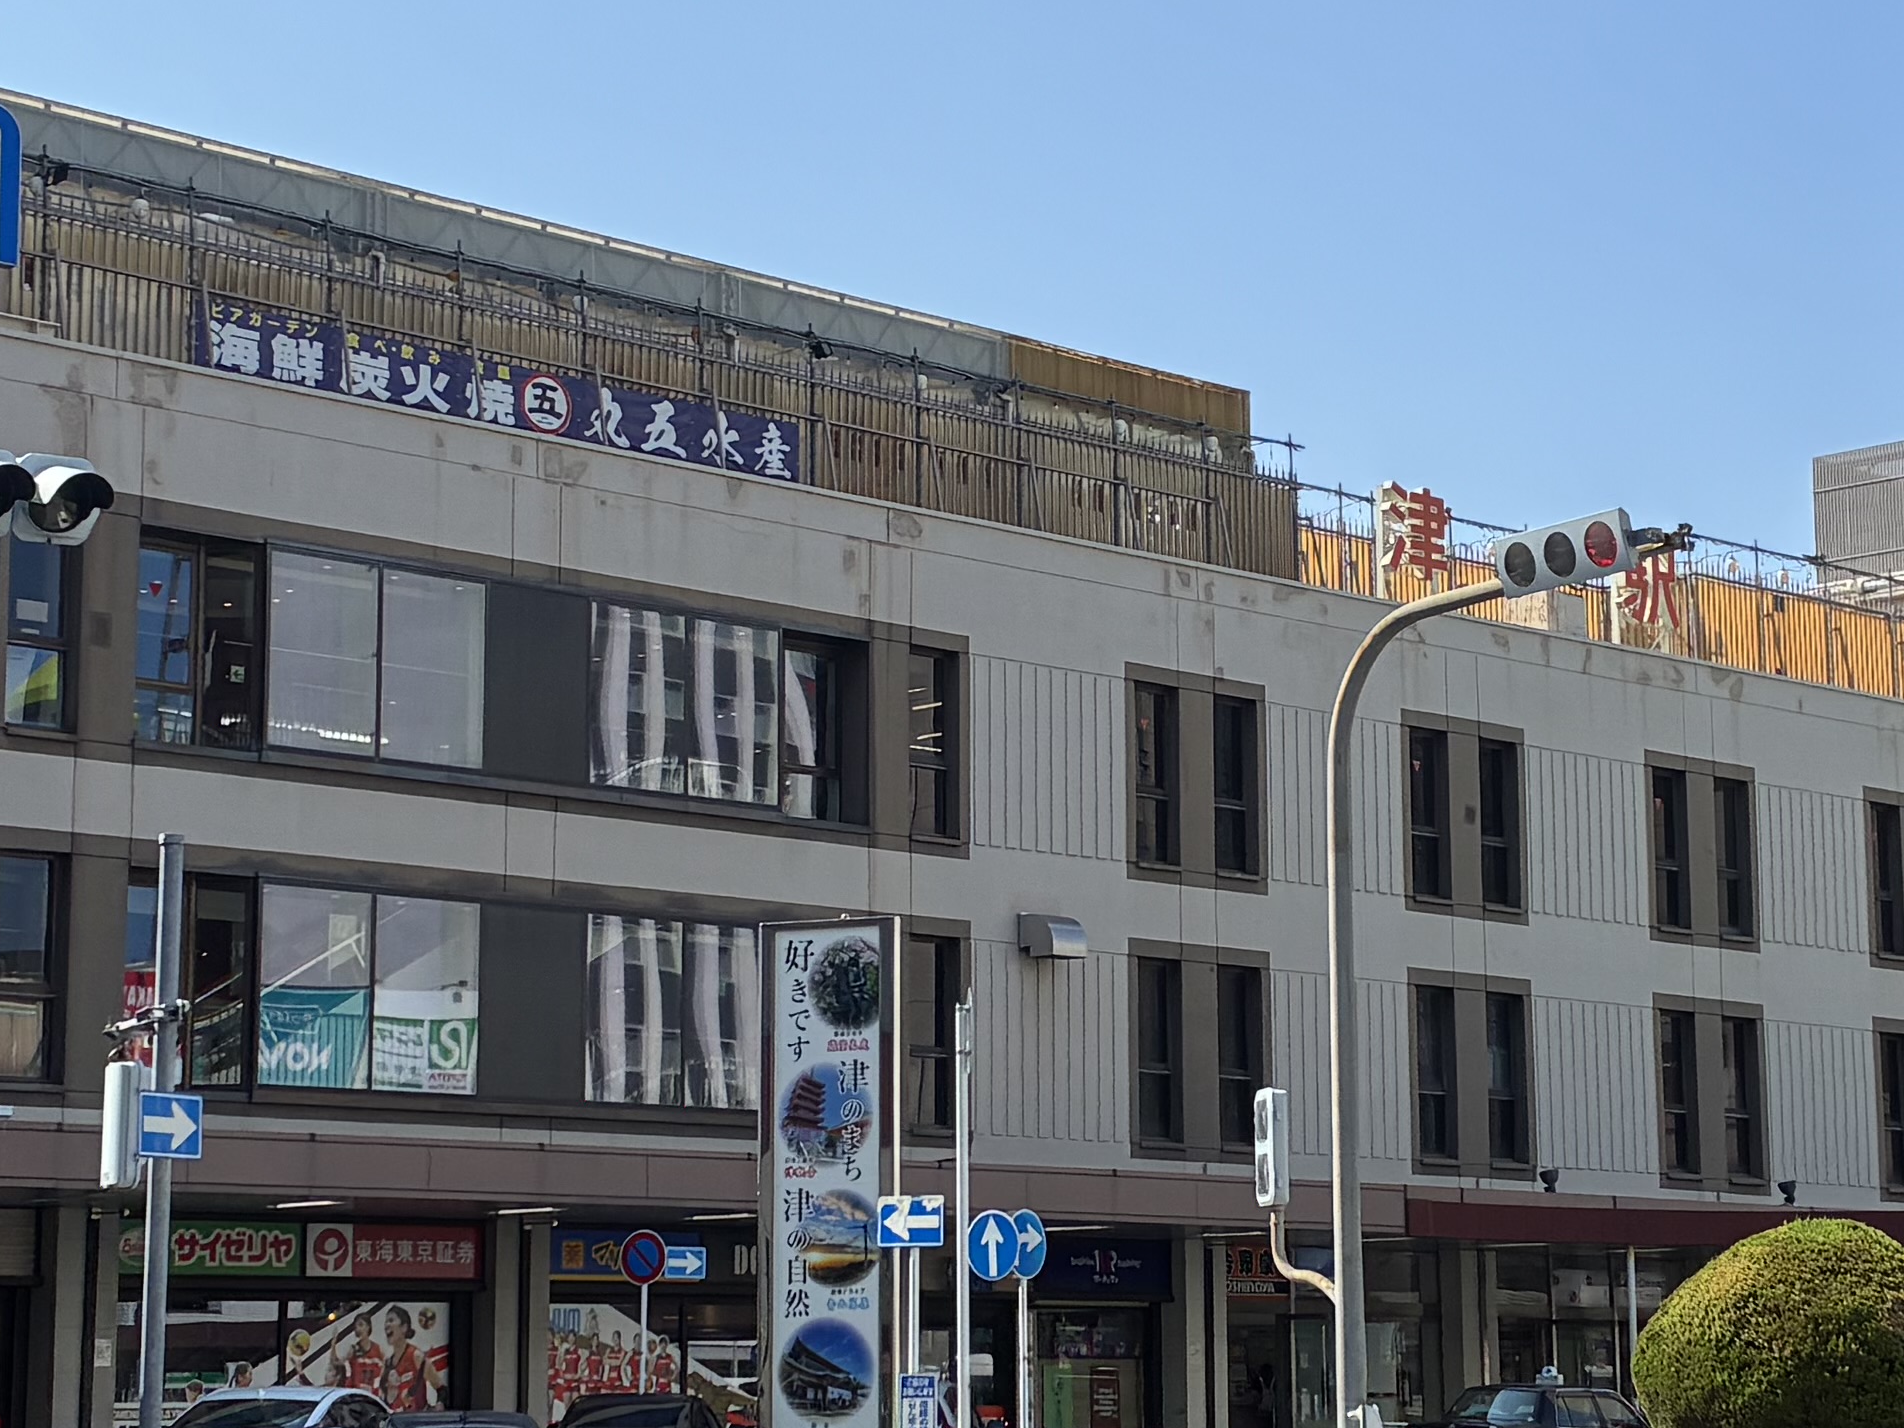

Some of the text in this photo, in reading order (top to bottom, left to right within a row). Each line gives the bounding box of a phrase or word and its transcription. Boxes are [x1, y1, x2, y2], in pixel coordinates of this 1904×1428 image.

[784, 939, 815, 1063] 好きです
[171, 1227, 296, 1269] サイゼリヤ
[354, 1238, 476, 1266] 東海東京証券
[783, 1187, 816, 1319] 津の自然
